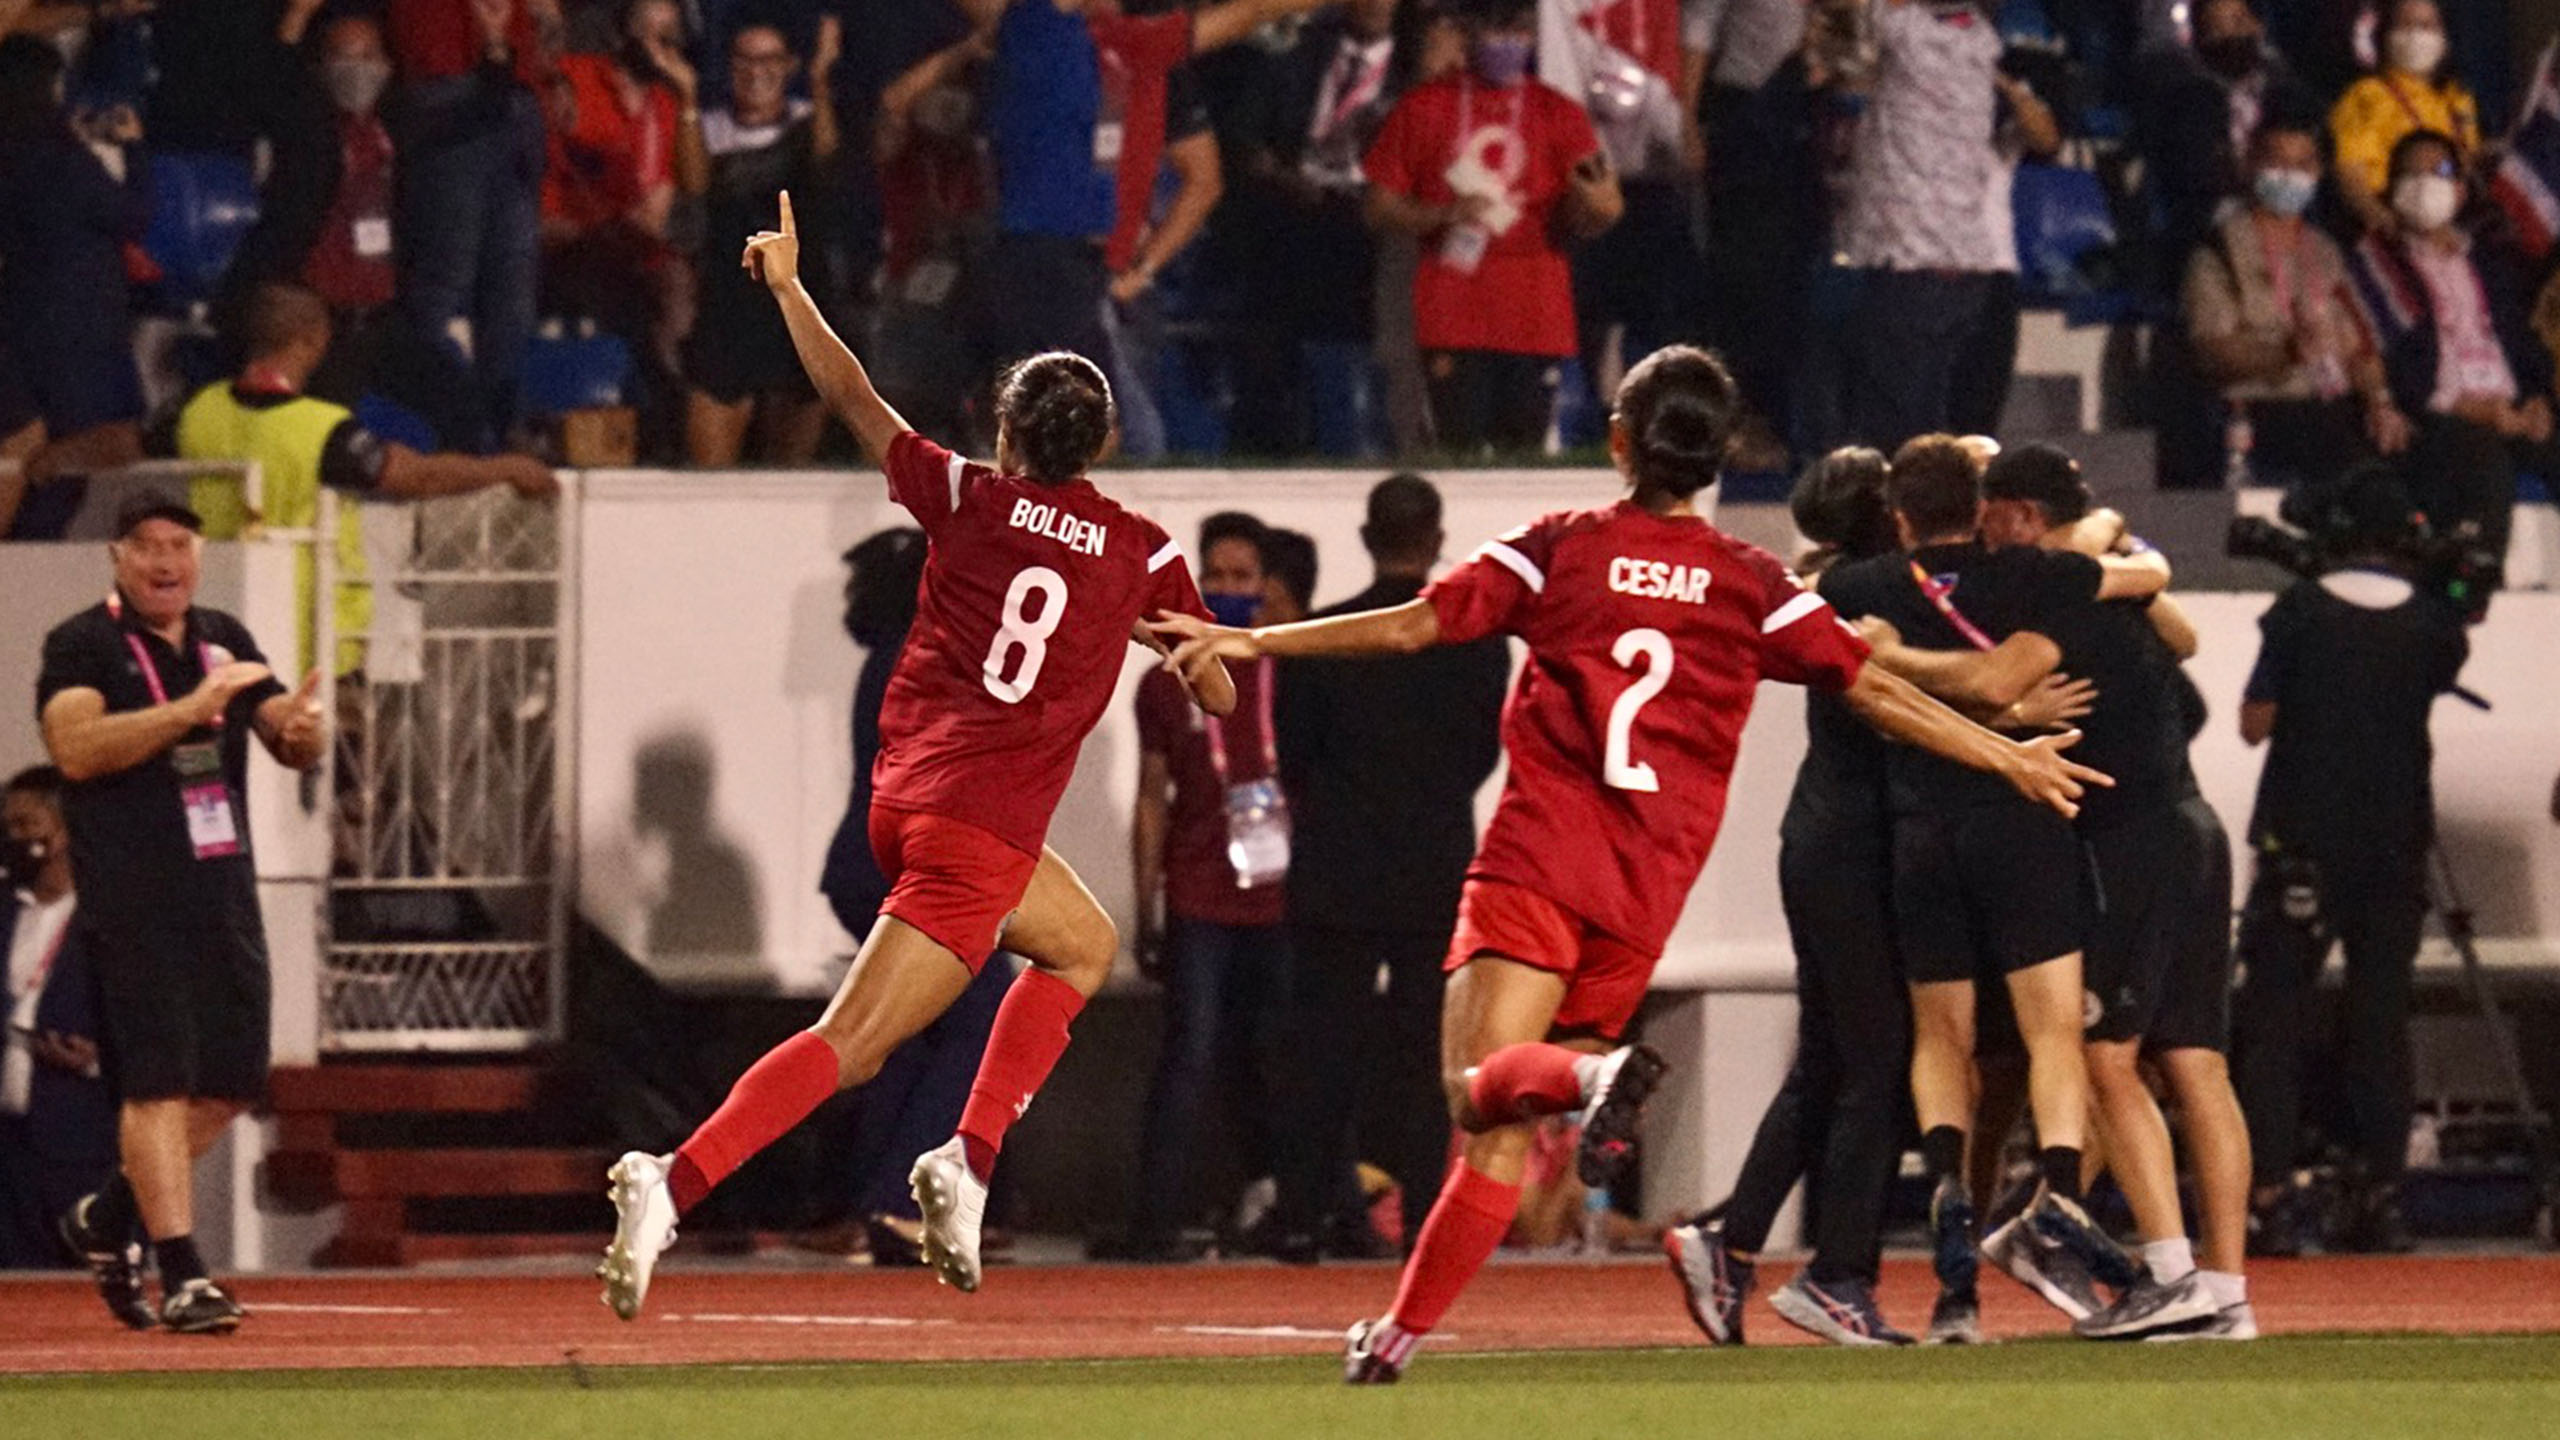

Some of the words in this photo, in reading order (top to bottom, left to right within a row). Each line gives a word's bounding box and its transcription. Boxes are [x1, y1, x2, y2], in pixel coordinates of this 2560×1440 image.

[1009, 497, 1107, 557] BOLDEN
[1608, 557, 1712, 605] CESAR
[982, 566, 1069, 704] 8
[1603, 628, 1675, 793] 2
